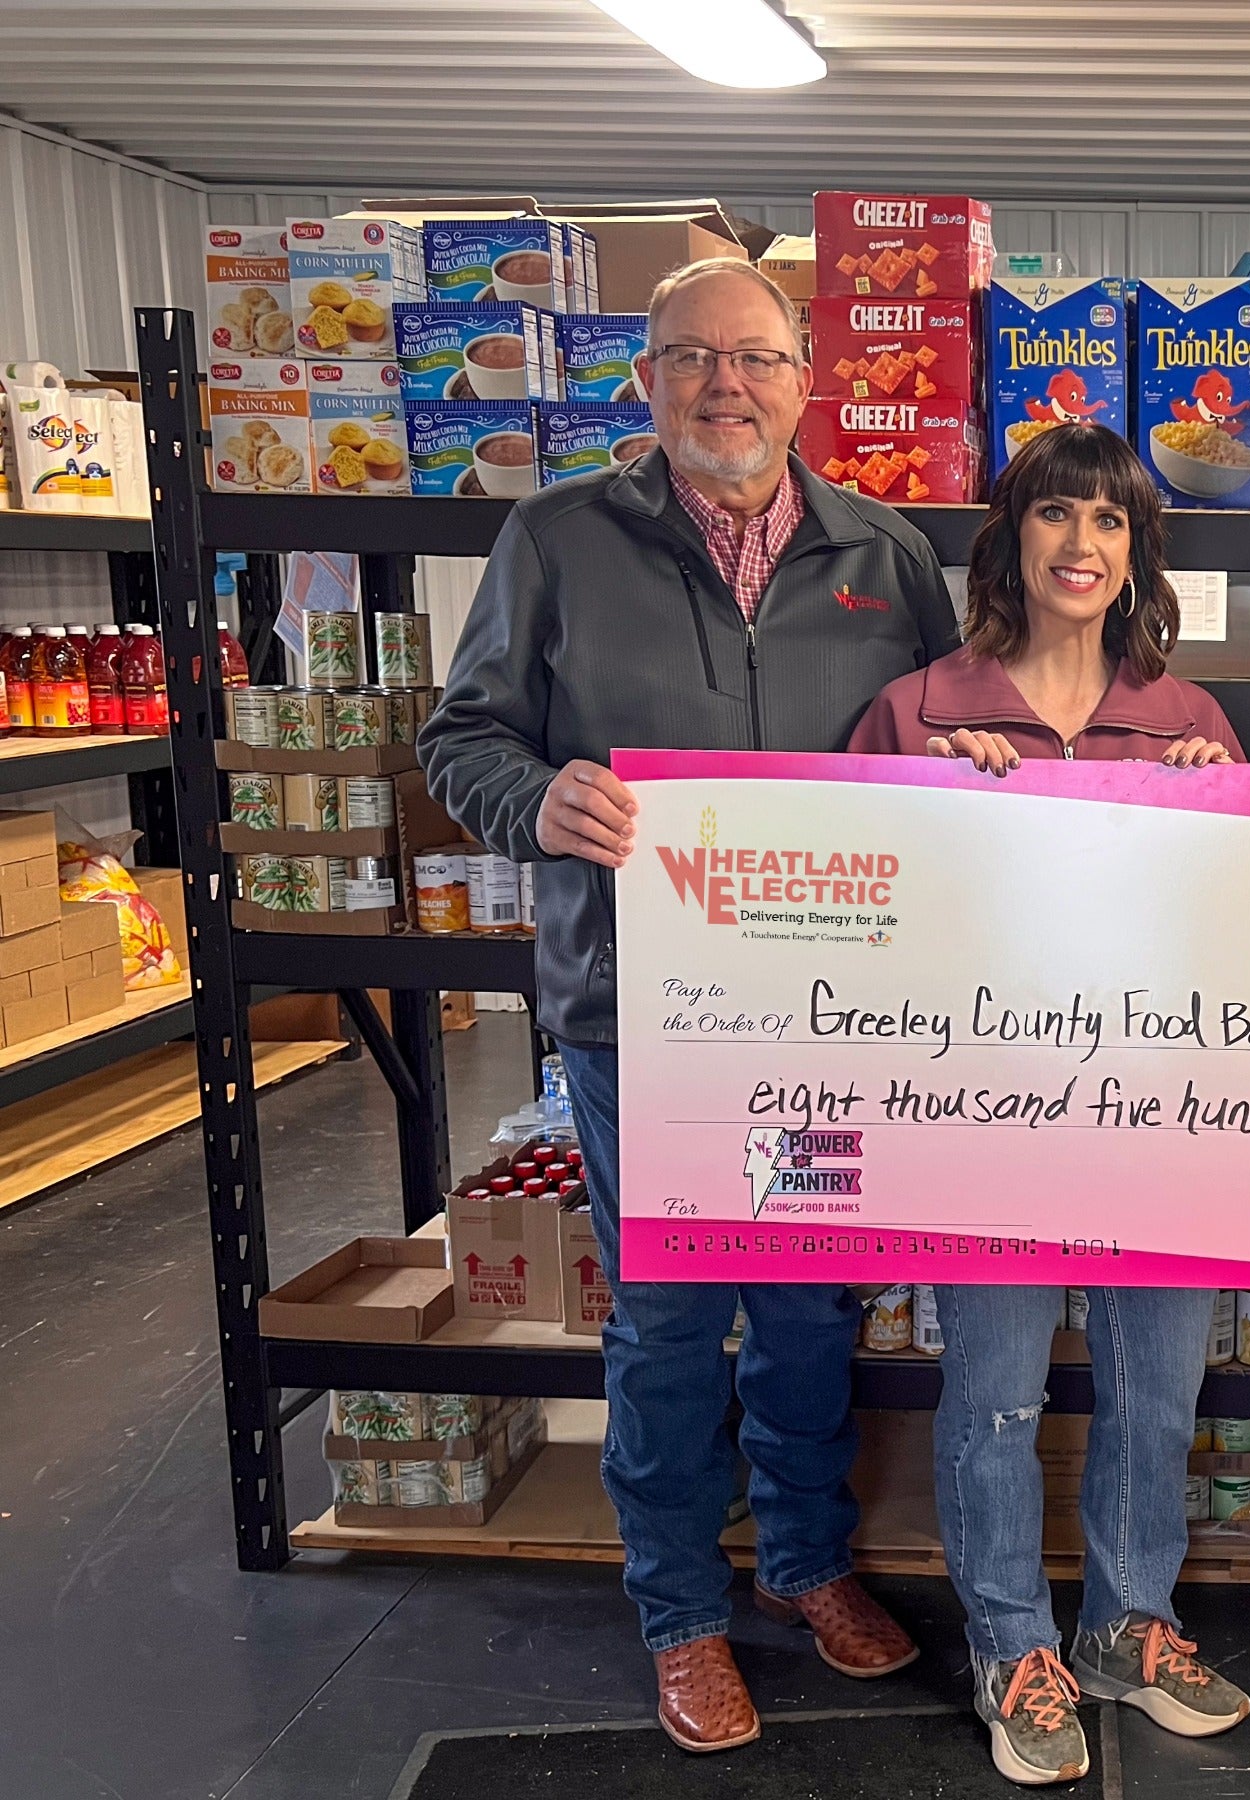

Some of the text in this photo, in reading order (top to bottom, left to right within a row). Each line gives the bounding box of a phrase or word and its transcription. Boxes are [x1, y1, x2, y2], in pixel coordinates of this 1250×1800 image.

[955, 214, 966, 225] Go
[459, 244, 476, 253] COCOA
[477, 243, 488, 252] MIX
[295, 256, 330, 267] CORN
[432, 253, 491, 271] MILK CHOCOLATE
[219, 266, 266, 277] BAKING
[953, 316, 964, 327] Go
[430, 328, 447, 338] COCOA
[447, 326, 459, 335] MIX
[402, 337, 462, 356] MILK CHOCOLATE
[999, 328, 1117, 371] Twinkles
[570, 347, 630, 366] MILK CHOCOLATE
[284, 371, 295, 379] 10
[221, 400, 296, 412] BAKING MIX
[316, 399, 348, 410] CORN
[947, 417, 959, 427] Go
[413, 434, 472, 453] MILK CHOCOLATE
[547, 434, 609, 453] MILK CHOCOLATE
[655, 846, 900, 912] WHEATLAND
[707, 876, 892, 926] ELECTRIC
[740, 910, 898, 927] Delivering Energy for Life
[750, 931, 791, 940] Touchstone
[821, 933, 864, 943] Cooperative
[663, 979, 726, 1006] Pay to
[664, 1013, 794, 1040] the Order Of
[810, 979, 951, 1059] Greeley
[972, 986, 1101, 1063] County
[1124, 989, 1207, 1047] Food
[748, 1078, 865, 1132] eight
[880, 1076, 1078, 1128] thousand
[1087, 1077, 1161, 1128] five
[789, 1134, 855, 1154] POWER
[782, 1172, 855, 1192] PANTRY
[663, 1197, 699, 1216] For
[801, 1203, 825, 1213] FOOD
[828, 1203, 860, 1213] BANKS
[473, 1280, 521, 1292] FRAGILE
